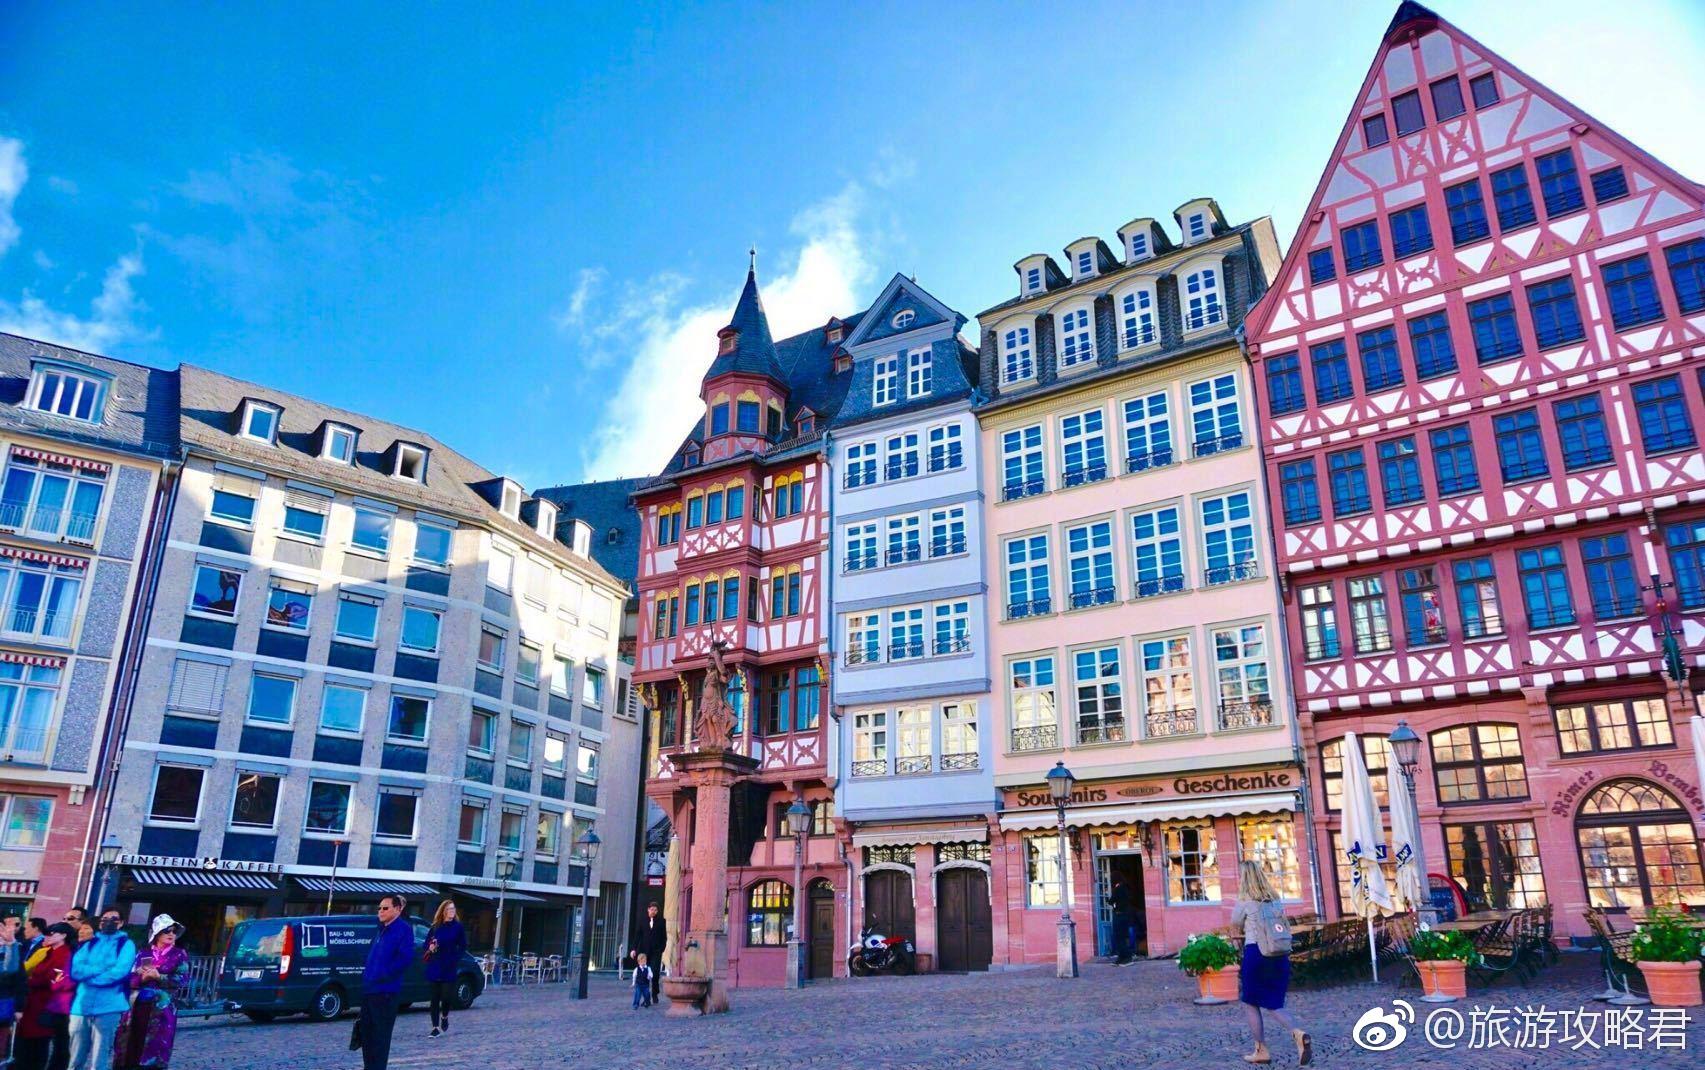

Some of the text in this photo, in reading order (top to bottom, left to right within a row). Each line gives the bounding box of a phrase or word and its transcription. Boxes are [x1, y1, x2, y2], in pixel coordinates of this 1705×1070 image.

[1173, 771, 1291, 794] Geschenke
[1648, 760, 1705, 812] Bembe
[1017, 787, 1108, 807] Sounirs
[121, 854, 285, 873] EINSTEIN KAFFEE
